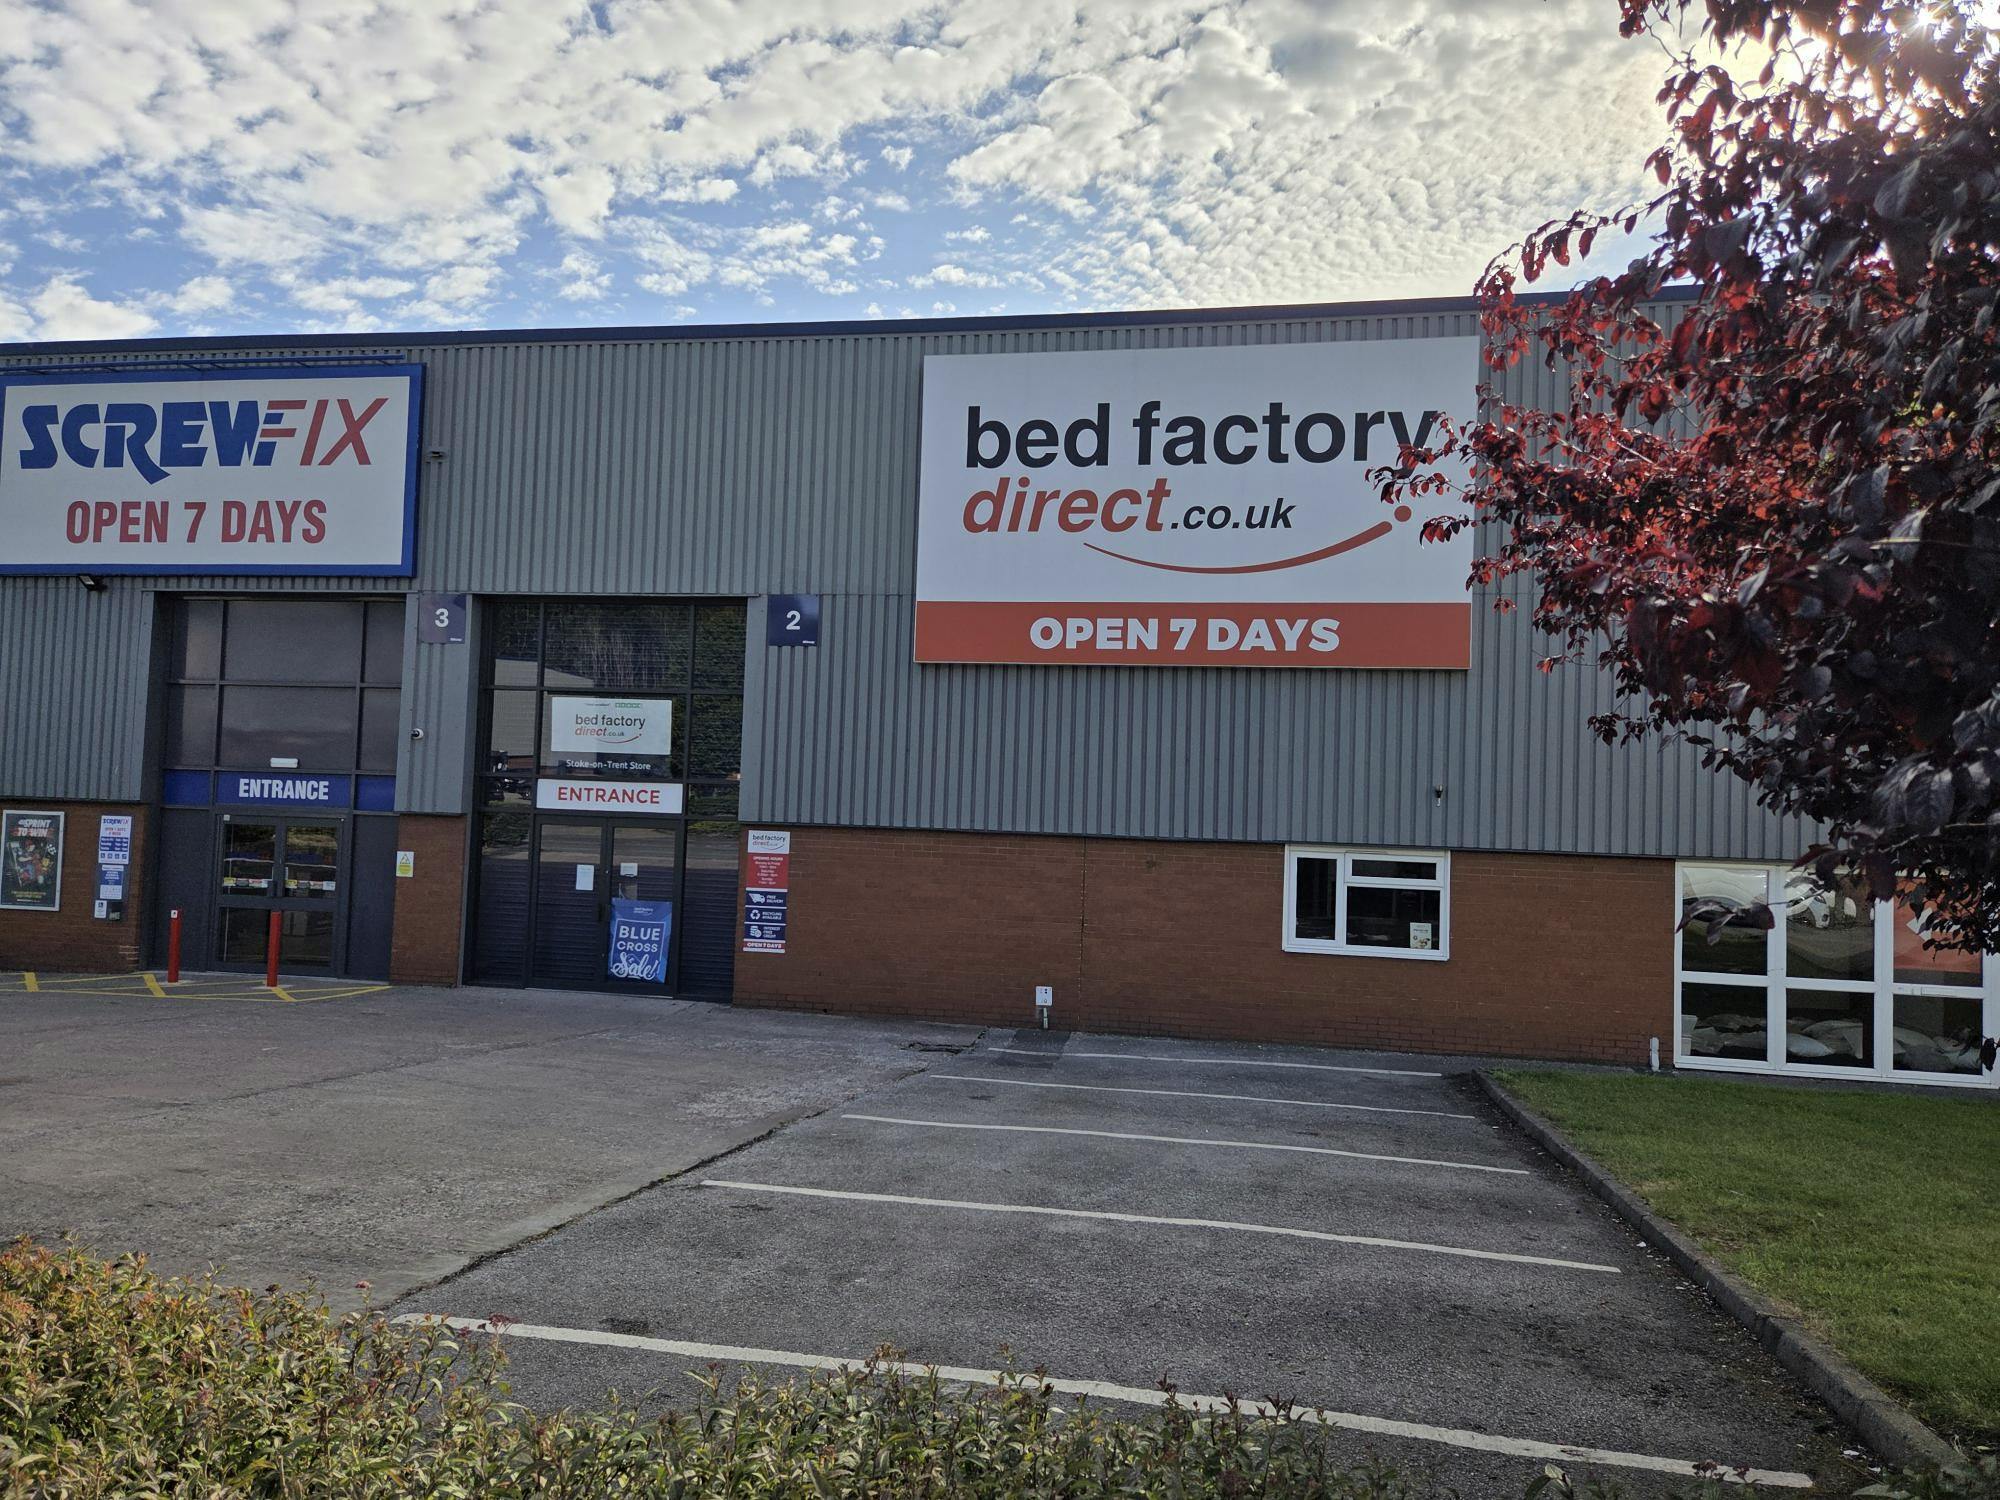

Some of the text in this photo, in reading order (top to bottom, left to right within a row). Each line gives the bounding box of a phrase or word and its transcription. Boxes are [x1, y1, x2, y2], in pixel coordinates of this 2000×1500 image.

[20, 398, 389, 485] SCREWFIX
[965, 400, 1439, 479] bed factory
[66, 500, 327, 544] OPEN 7 DAYS
[435, 608, 449, 628] 3
[786, 610, 801, 630] 2
[1029, 617, 1340, 652] OPEN 7 DAYS
[575, 713, 646, 730] bed factory
[566, 759, 652, 771] Stoke-on-Trent Store
[238, 778, 330, 800] ENTRANCE
[557, 786, 661, 805] ENTRANCE
[765, 834, 786, 843] factory
[619, 926, 661, 941] BLUE
[617, 941, 658, 952] CROSS
[610, 951, 659, 980] Sale!
